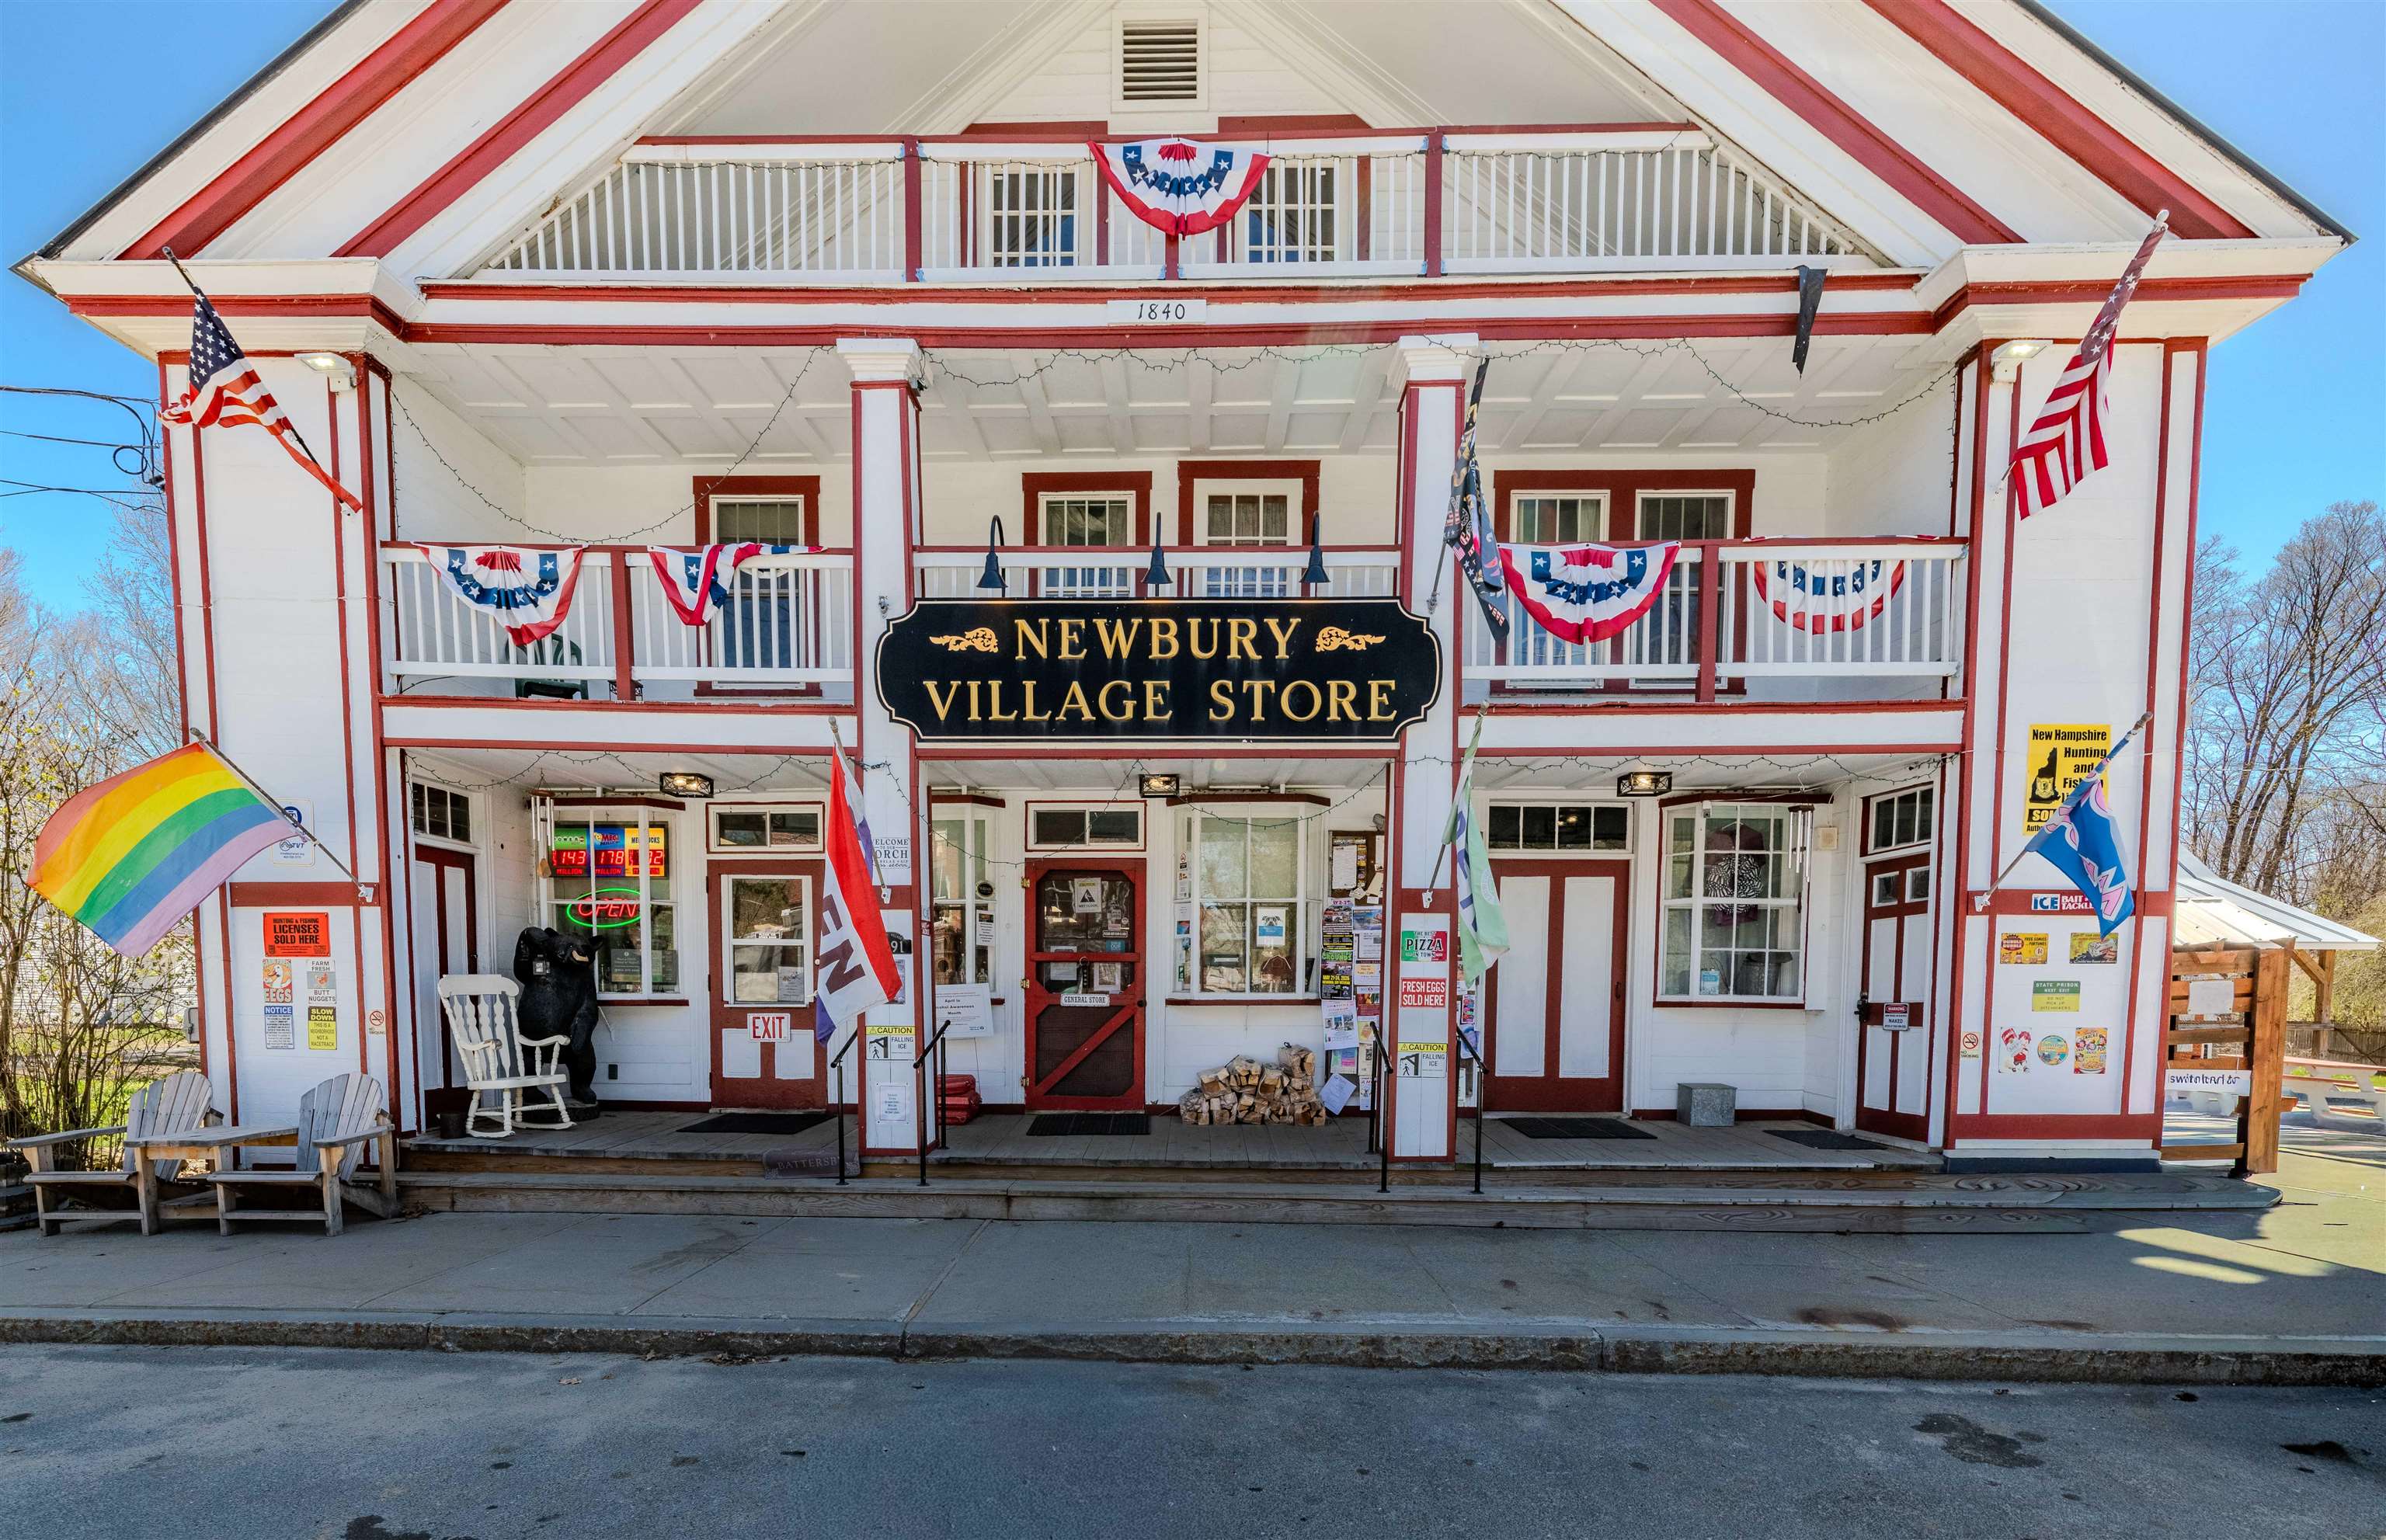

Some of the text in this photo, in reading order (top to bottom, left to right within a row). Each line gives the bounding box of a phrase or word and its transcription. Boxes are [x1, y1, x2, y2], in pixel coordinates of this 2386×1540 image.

[1137, 302, 1186, 321] 1840
[1014, 618, 1301, 660] NEWBURY
[923, 679, 1397, 722] VILLAGE STORE
[2032, 729, 2107, 742] New Hampshire
[2064, 747, 2107, 759] Hunting
[2074, 763, 2094, 773] and
[577, 898, 638, 918] OPEN
[2033, 897, 2058, 909] ICE
[273, 924, 319, 934] LICENSES
[274, 934, 319, 944] SOLD HERE
[1406, 938, 1444, 951] PIZZA
[1402, 982, 1445, 992] FRESH EGGS
[1402, 994, 1445, 1006] SOLD HERE
[752, 1016, 784, 1039] EXIT
